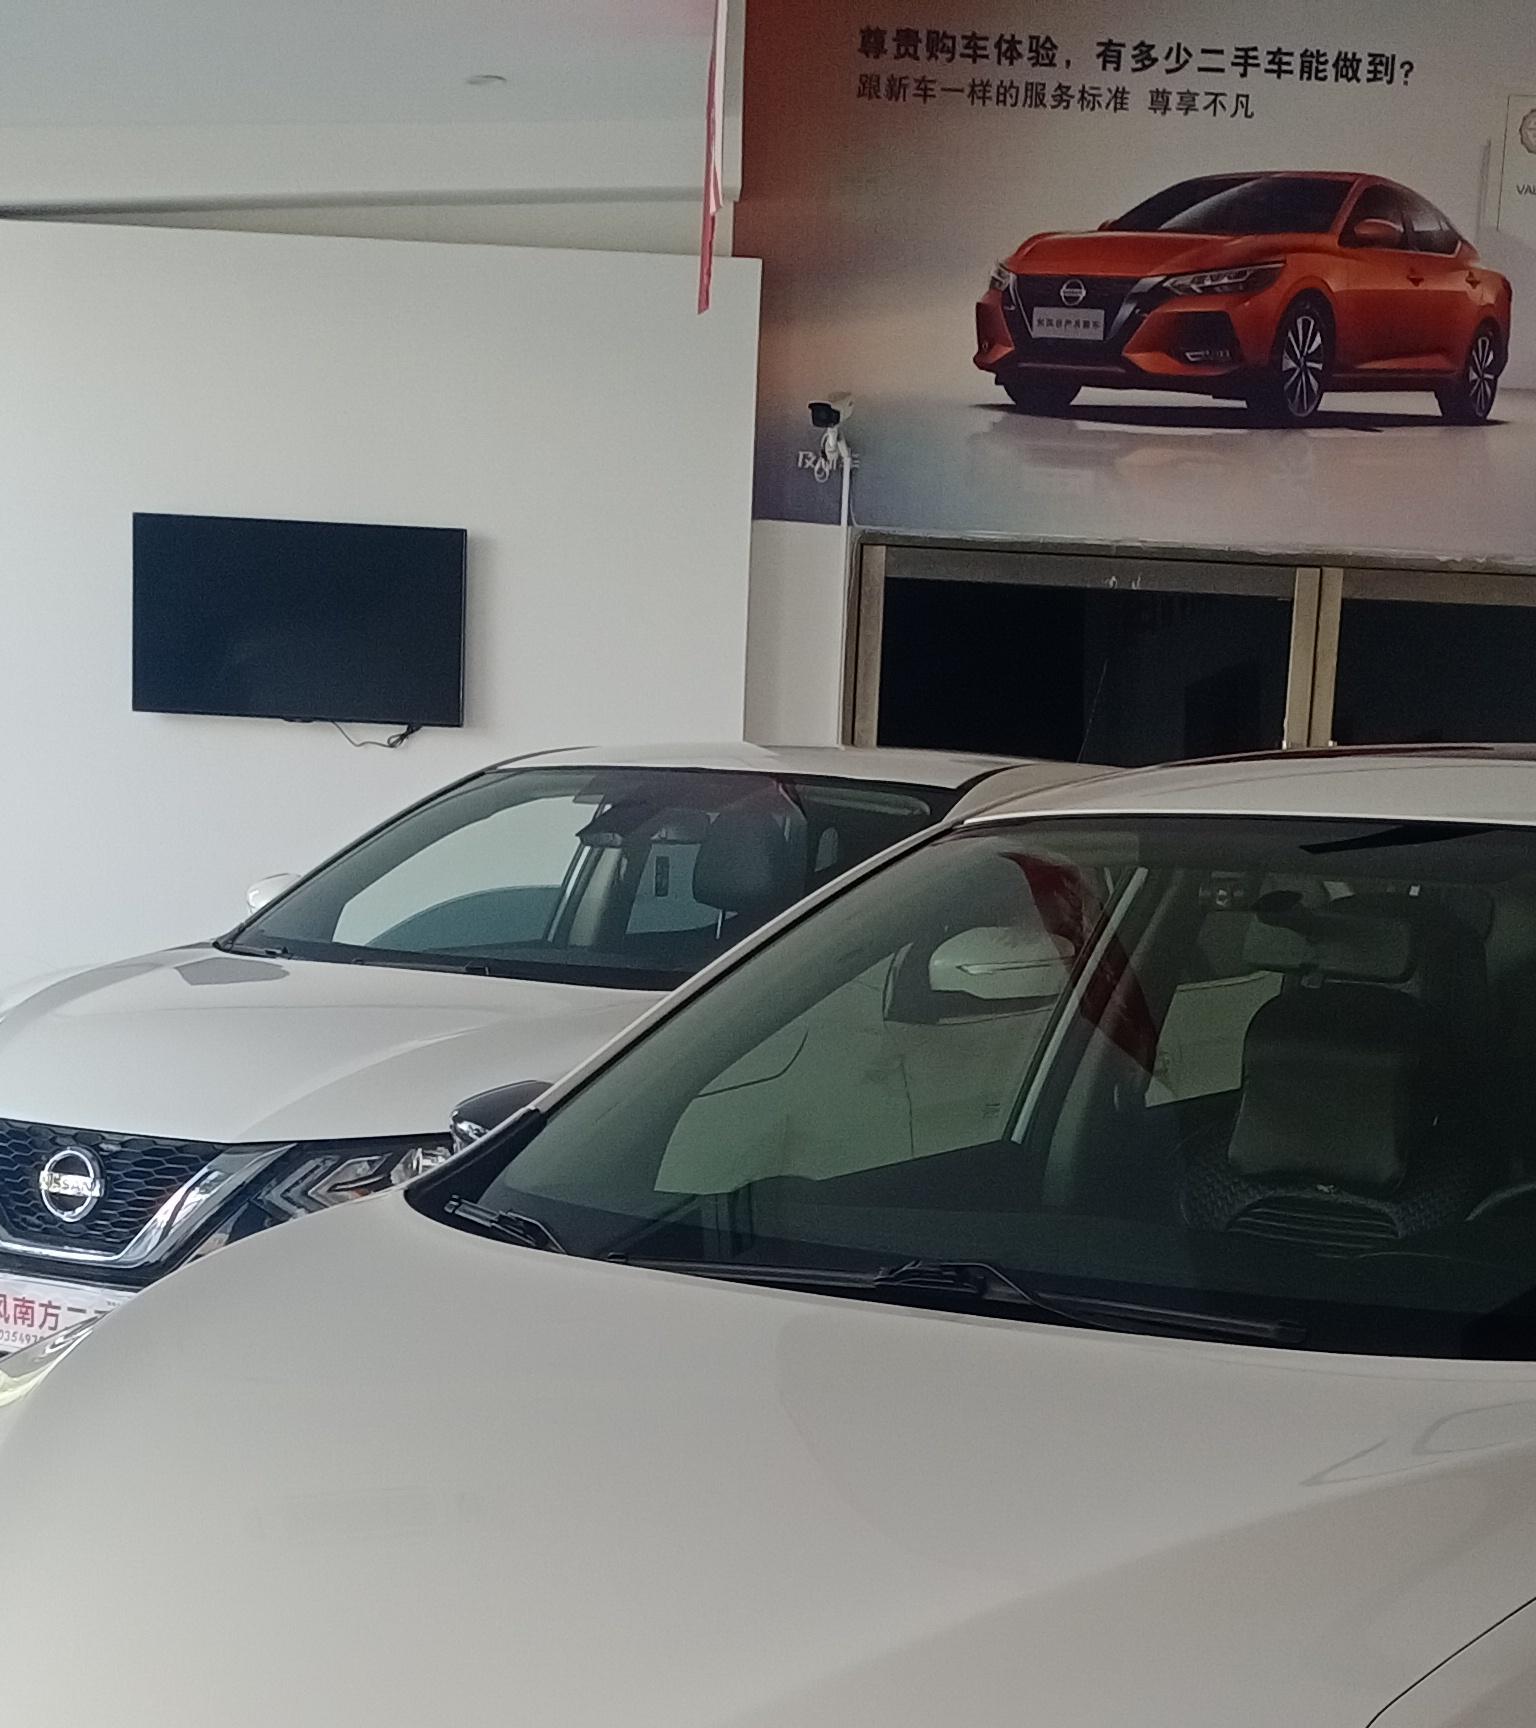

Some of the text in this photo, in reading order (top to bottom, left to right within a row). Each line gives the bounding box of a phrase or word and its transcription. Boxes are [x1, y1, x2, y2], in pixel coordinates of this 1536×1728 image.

[856, 73, 1255, 119] 跟新车一样的服务标准 尊享不凡
